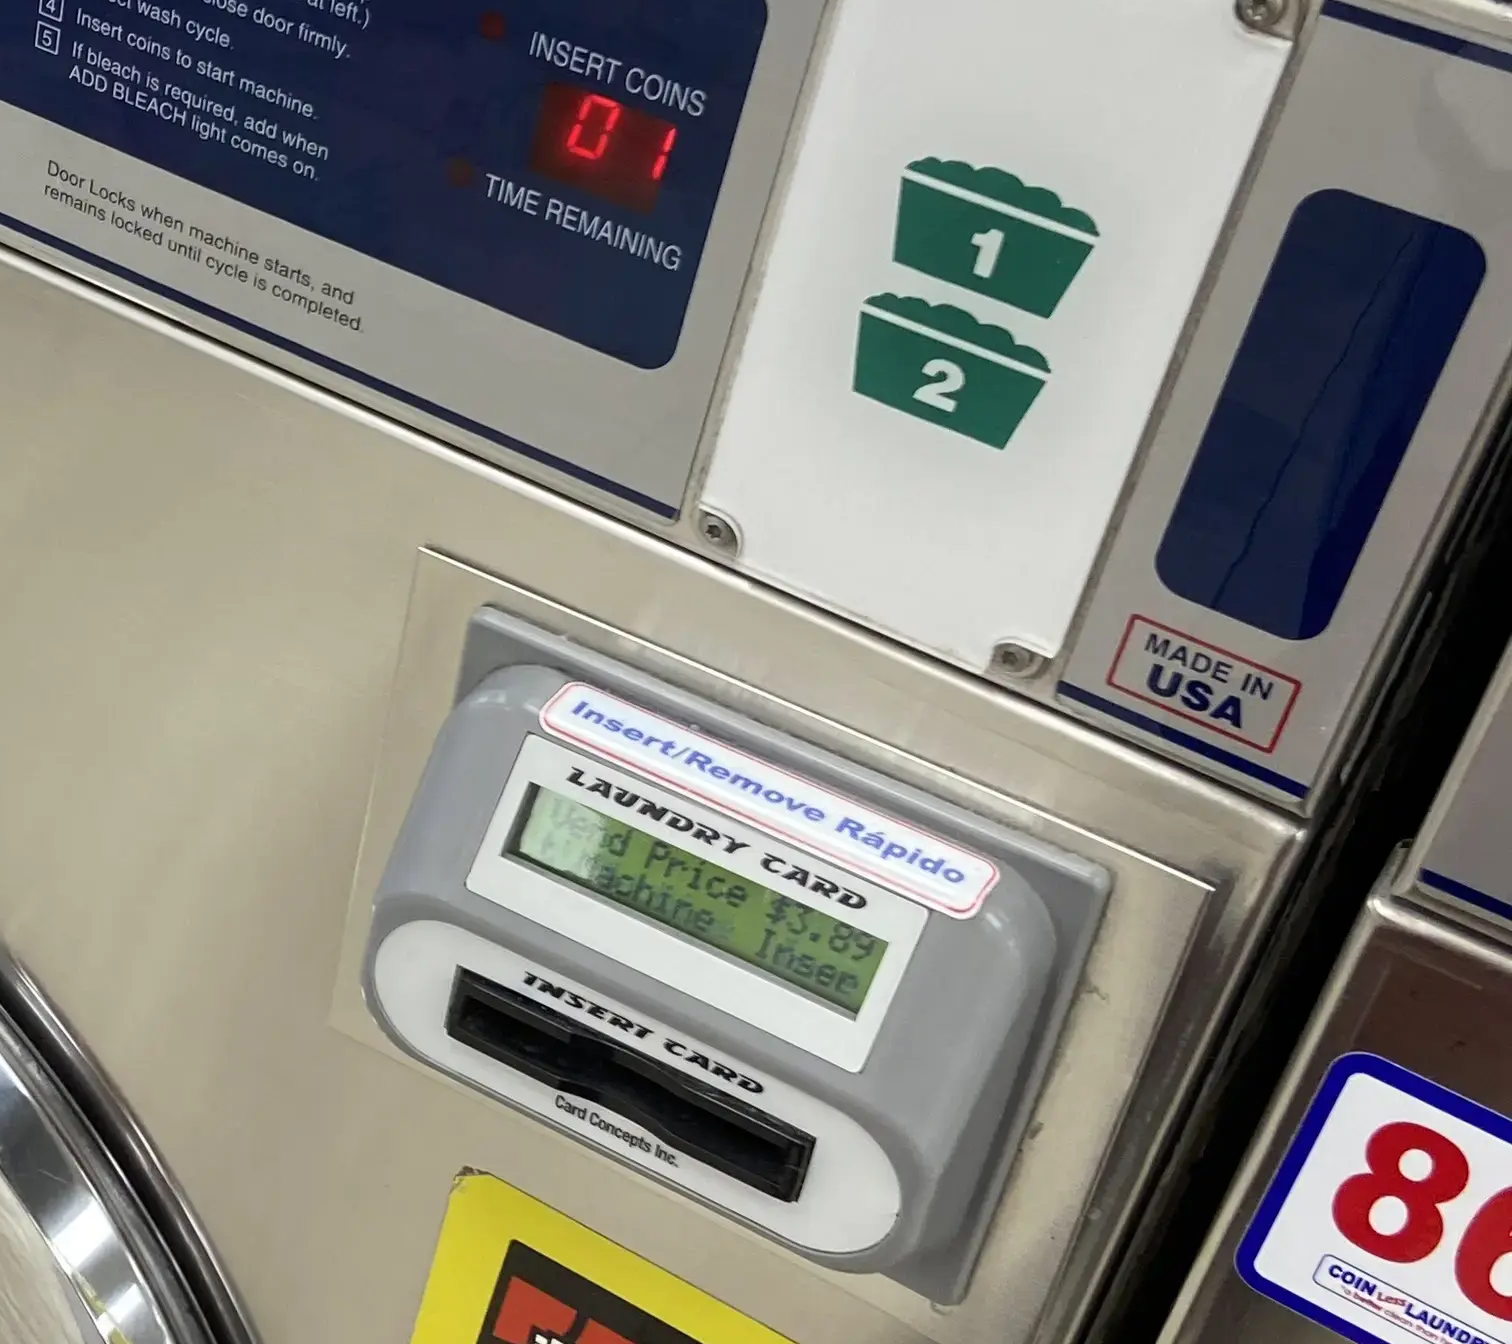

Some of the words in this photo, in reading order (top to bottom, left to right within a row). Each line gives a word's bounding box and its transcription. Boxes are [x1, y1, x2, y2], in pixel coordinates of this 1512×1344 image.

[75, 7, 123, 42] Insert
[126, 30, 171, 61] coins
[175, 48, 192, 69] to
[196, 58, 236, 88] start
[238, 76, 320, 121] machine.
[185, 16, 236, 52] cycle.
[252, 5, 294, 36] door
[298, 21, 351, 59] firmly.
[528, 31, 622, 85] INSERT
[624, 66, 709, 118] COINS
[68, 64, 108, 93] ADD
[111, 80, 187, 127] BLEACH
[190, 113, 227, 145] light
[229, 133, 288, 170] comes
[292, 159, 320, 182] on.
[71, 41, 84, 59] If
[86, 46, 141, 85] bleach
[145, 71, 160, 92] is
[164, 82, 240, 126] required,
[243, 113, 277, 140] add
[281, 130, 329, 161] when
[565, 92, 679, 182] 01
[485, 172, 542, 217] TIME
[544, 197, 684, 273] REMAINING
[970, 227, 1006, 280] 1
[912, 358, 967, 414] 2
[1143, 632, 1234, 685] MADE
[1240, 672, 1274, 702] IN
[1146, 662, 1242, 730] USA
[570, 699, 827, 823] Insert/Remove
[834, 816, 967, 886] Rápido
[565, 765, 752, 856] LAUNDRY
[759, 851, 869, 911] CARD
[644, 840, 750, 909] Price
[766, 892, 878, 962] $3.89
[520, 970, 656, 1041] INSERT
[662, 1037, 765, 1095] CARD
[554, 1094, 588, 1122] Card
[588, 1110, 653, 1154] Concepts
[654, 1142, 680, 1168] Inc.
[1327, 1263, 1378, 1297] COIN
